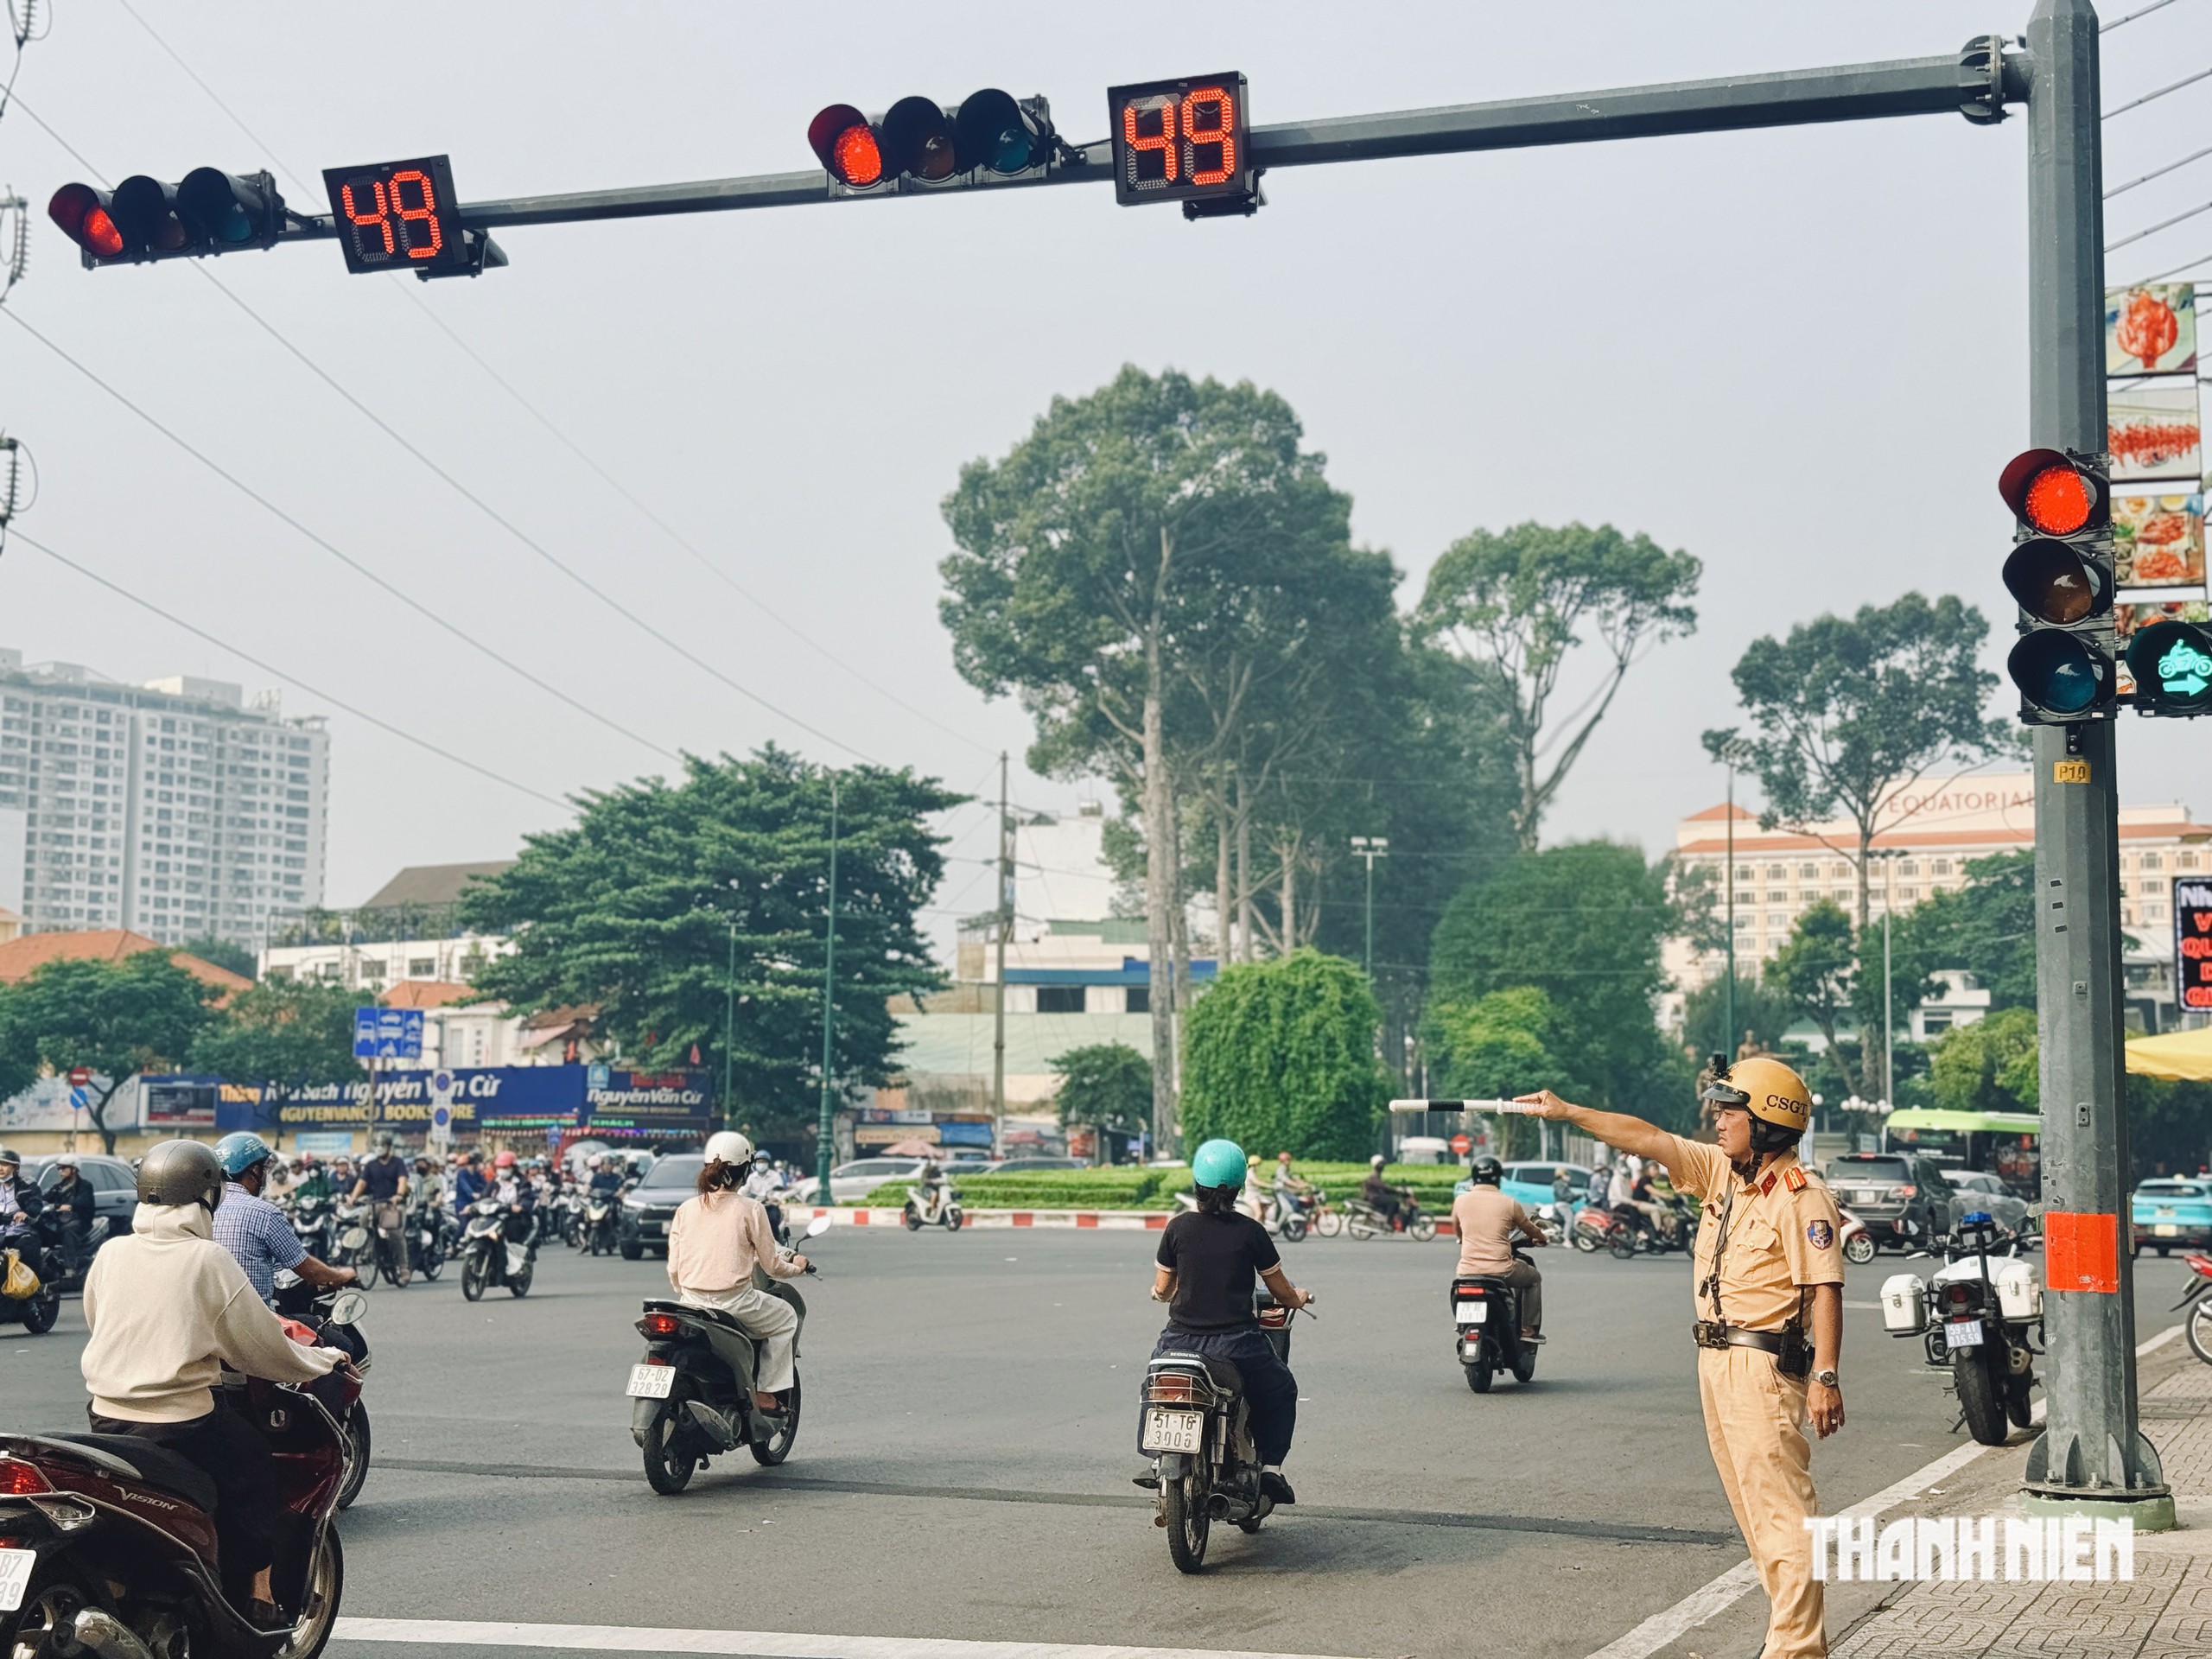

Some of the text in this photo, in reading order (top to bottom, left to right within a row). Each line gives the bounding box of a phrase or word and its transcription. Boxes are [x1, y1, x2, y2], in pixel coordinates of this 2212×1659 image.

[1123, 86, 1235, 187] 49
[341, 170, 443, 258] 49
[1888, 790, 2036, 817] EQUATORIAL
[384, 1103, 476, 1121] BOOKSORE
[1766, 1094, 1808, 1116] CSGT
[112, 1484, 178, 1510] VISION
